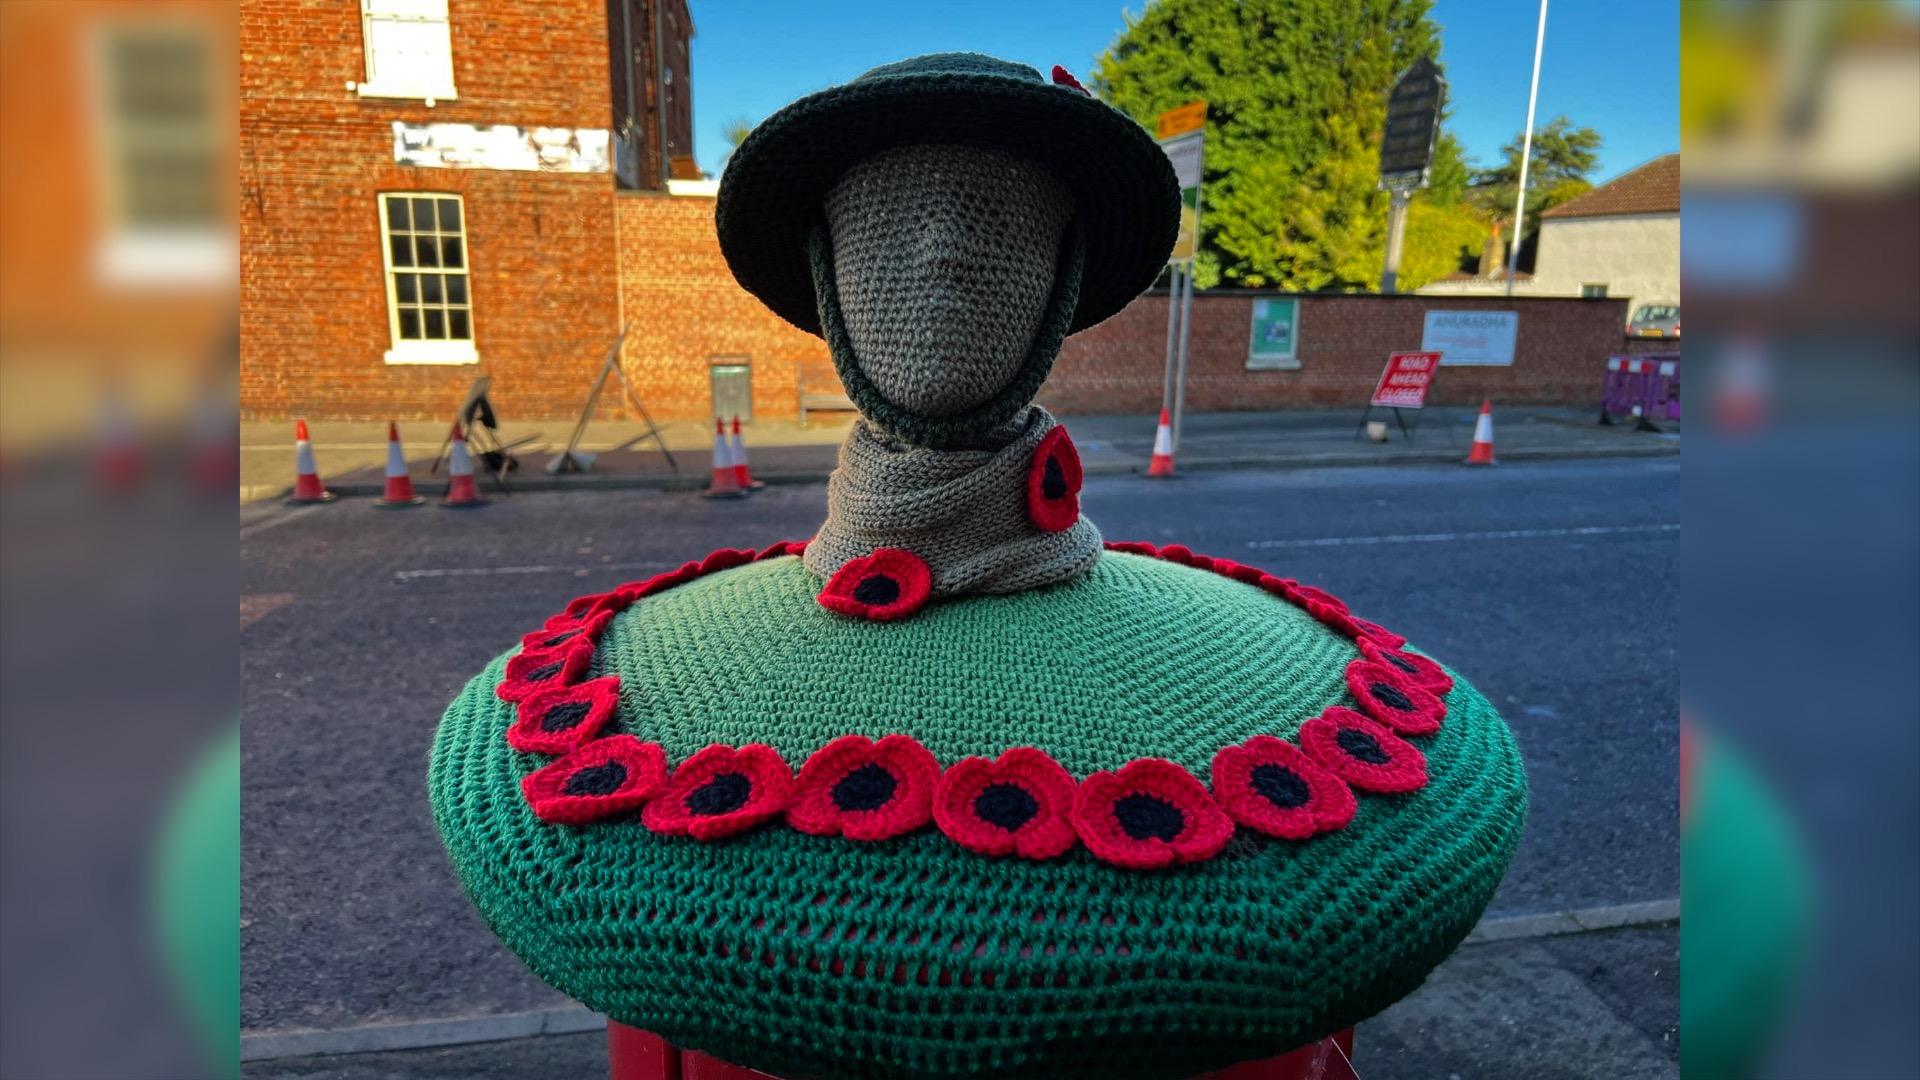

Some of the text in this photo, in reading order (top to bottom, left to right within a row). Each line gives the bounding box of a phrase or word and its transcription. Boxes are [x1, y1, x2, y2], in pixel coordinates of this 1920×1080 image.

[1399, 357, 1430, 369] ROAD
[1389, 373, 1427, 385] AHEAD
[1380, 387, 1424, 401] CLOSED
